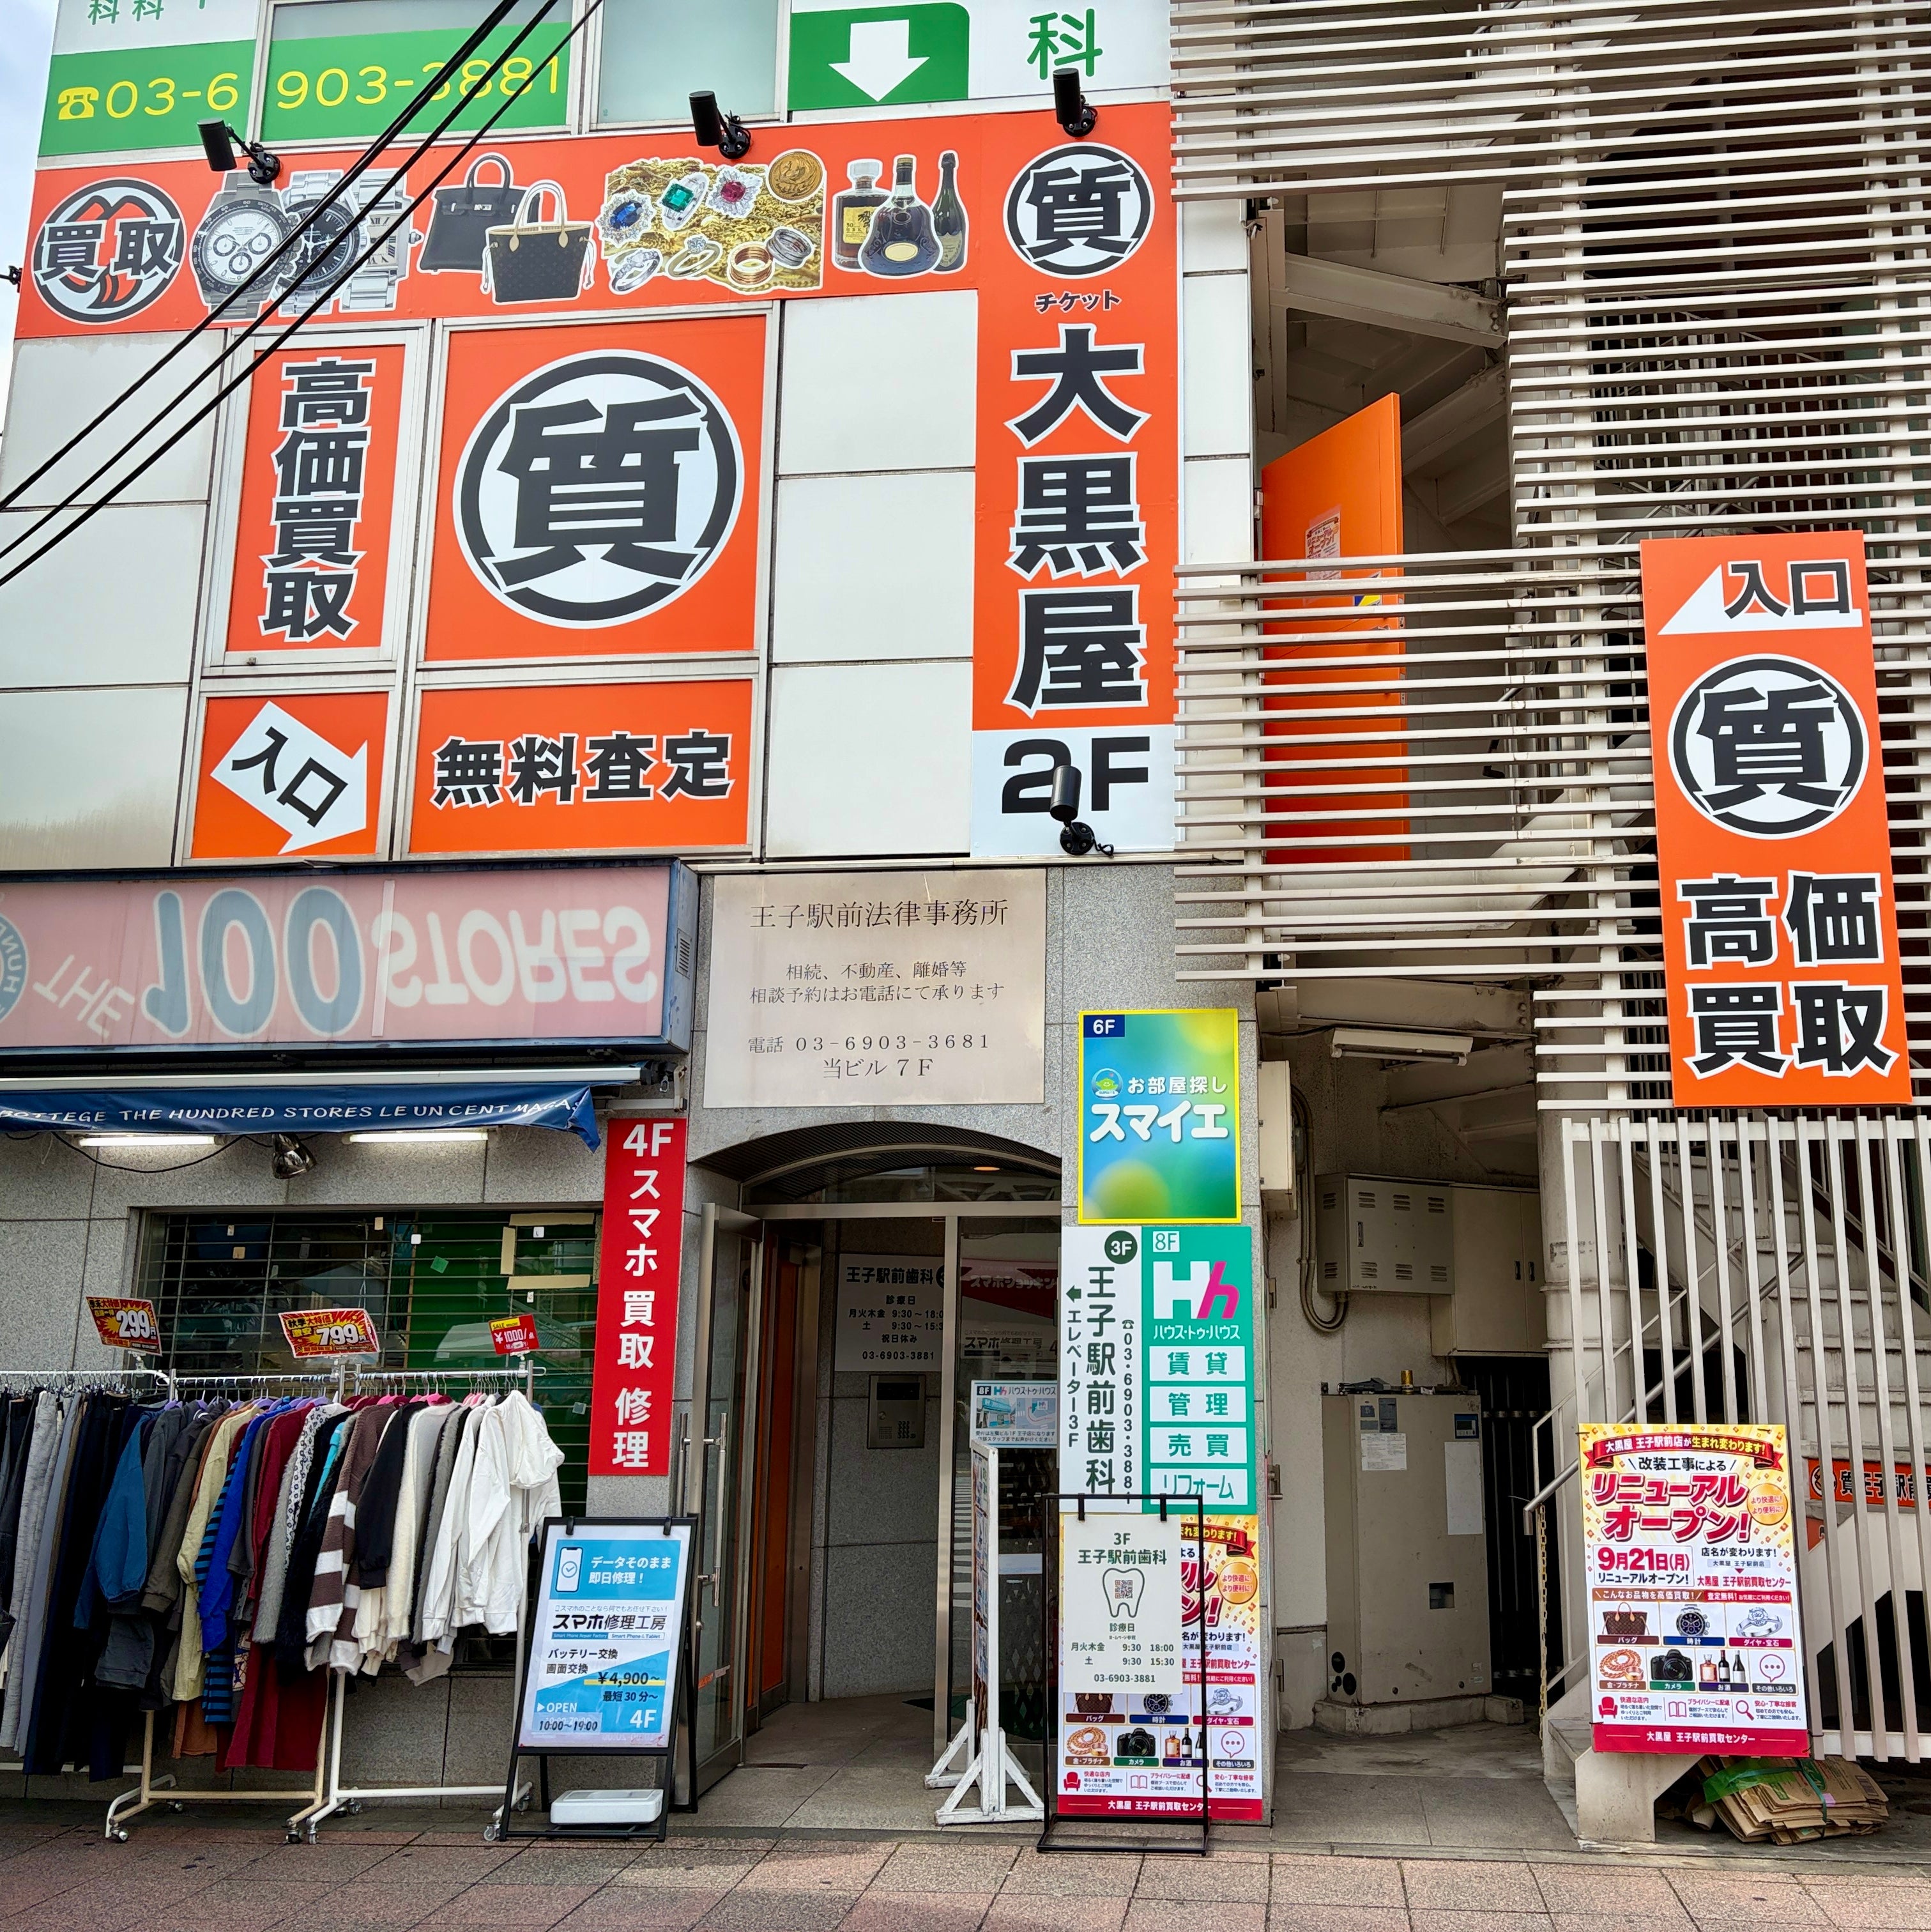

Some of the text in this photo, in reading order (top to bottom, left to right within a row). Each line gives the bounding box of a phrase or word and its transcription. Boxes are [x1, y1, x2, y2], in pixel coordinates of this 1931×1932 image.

[1027, 9, 1103, 80] 科
[42, 218, 183, 285] 買取
[1035, 289, 1122, 314] チケット
[259, 356, 377, 642] 高価買取
[1004, 323, 1152, 718] 大黒屋
[1725, 560, 1854, 617] 入口
[429, 730, 733, 808] 無料査定
[1001, 736, 1150, 815] 2F
[232, 727, 347, 827] 入口
[749, 899, 1009, 929] 王子駅前法律事務所
[786, 961, 967, 980] 相続、不動産、離婚等
[749, 983, 1005, 1004] 相談予約はお電話にて承ります
[1093, 1019, 1115, 1034] 6F
[749, 1034, 989, 1054] 電話 03-6903-3681
[1128, 1076, 1226, 1094] お部屋探し
[119, 1109, 163, 1121] THE
[169, 1108, 275, 1120] HUNDRED
[284, 1107, 372, 1119] STORES
[380, 1106, 407, 1117] LE
[414, 1105, 443, 1117] UN
[448, 1103, 509, 1116] CENT
[1090, 1100, 1228, 1143] スマイエ
[623, 1123, 674, 1157] 4F
[1110, 1239, 1133, 1256] 3F
[1155, 1232, 1177, 1251] 8F
[846, 1266, 933, 1285] 王子駅前歯科
[886, 1295, 915, 1305] 診療日
[849, 1309, 885, 1318] 月火木金
[862, 1321, 871, 1330] 土
[882, 1334, 917, 1343] 祝日休み
[862, 1351, 935, 1360] 03-6903-3881
[1087, 1266, 1116, 1494] 王子駅前歯科
[979, 1386, 989, 1395] 8F
[1605, 1439, 1633, 1453] 大黒屋
[1638, 1457, 1726, 1471] 改装工事による
[1163, 1475, 1234, 1500] リフォーム
[1592, 1472, 1750, 1507] リニューアル
[1603, 1503, 1752, 1544] オープン!
[1113, 1533, 1131, 1545] 3F
[1078, 1549, 1167, 1565] 王子駅前歯科
[1598, 1547, 1690, 1571] 9月21日(月)
[1701, 1547, 1776, 1557] 店名が変わります!
[591, 1556, 671, 1568] データそのまま
[588, 1572, 643, 1584] 即日修理!
[1598, 1573, 1689, 1584] リニューアルオープン!
[1697, 1575, 1791, 1588] 大黒屋 王子駅前買取センター
[1603, 1590, 1694, 1600] こんなお品物を高価買取!
[1707, 1591, 1737, 1601] 査定無料!
[553, 1614, 668, 1630] スマホ修理工房
[1109, 1623, 1135, 1632] 診療日
[548, 1648, 618, 1659] バッテリー交換
[1071, 1643, 1105, 1652] 月火木金
[546, 1663, 588, 1674] 画面交換
[1085, 1657, 1094, 1666] 土
[1122, 1657, 1141, 1666] 9:30
[1150, 1657, 1175, 1666] 15:30
[1094, 1674, 1156, 1683] 03-6903-3881
[1755, 1685, 1794, 1693] その他いろいろ
[547, 1703, 577, 1712] OPEN
[630, 1709, 657, 1728] 4F
[1647, 1732, 1756, 1744] 大黒屋 王子駅前買取センター
[1216, 1760, 1251, 1768] その他いろいろ
[1108, 1801, 1132, 1811] 大黒屋
